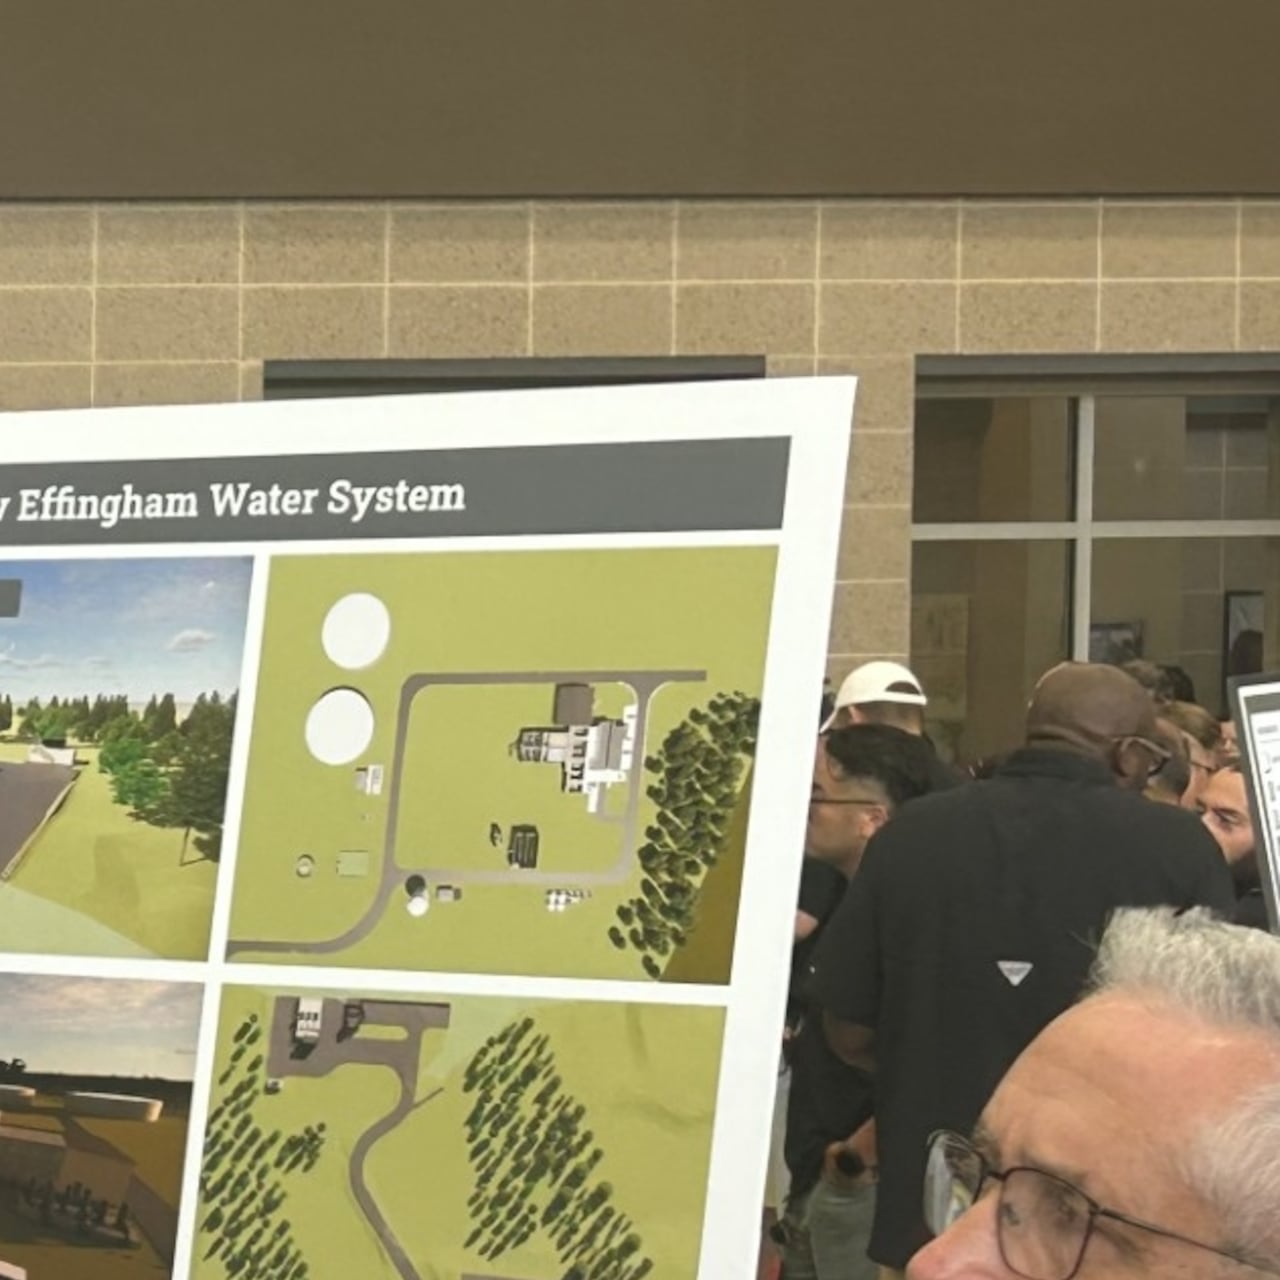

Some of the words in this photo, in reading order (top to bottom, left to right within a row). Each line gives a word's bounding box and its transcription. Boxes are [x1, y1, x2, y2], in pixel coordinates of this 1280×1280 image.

[17, 484, 199, 528] Effingham
[209, 483, 319, 517] Water
[327, 479, 466, 523] System
